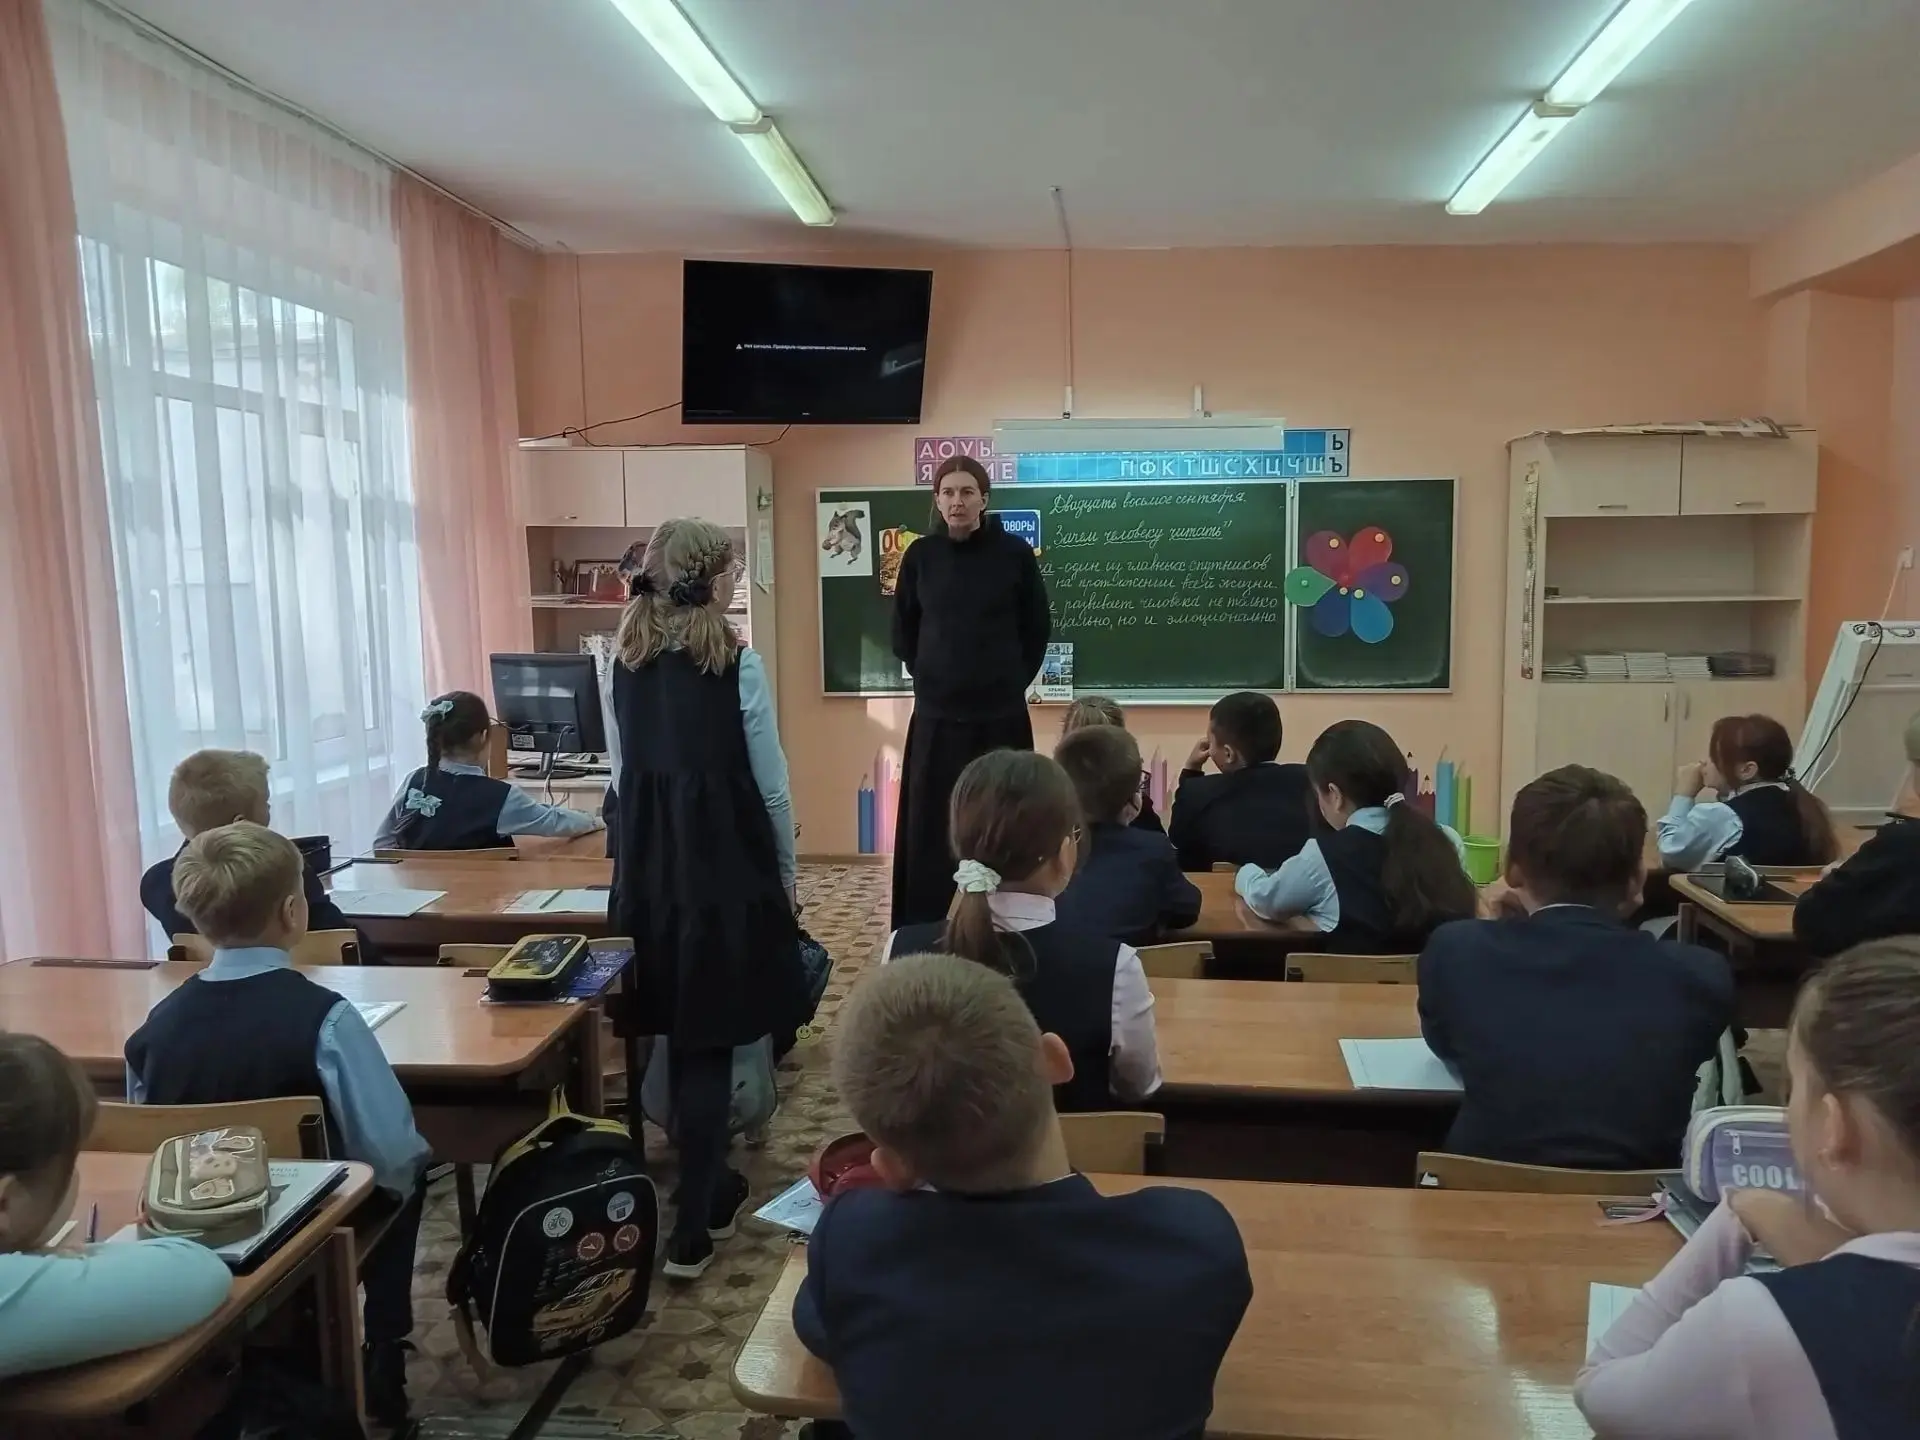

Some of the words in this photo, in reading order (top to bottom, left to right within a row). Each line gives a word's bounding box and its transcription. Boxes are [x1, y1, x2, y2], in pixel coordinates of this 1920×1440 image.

[1049, 494, 1117, 519] Двадцать
[1122, 491, 1173, 508] восьмое
[1103, 520, 1164, 549] человеку
[1106, 561, 1122, 580] из
[1127, 553, 1186, 571] главных
[1189, 553, 1272, 580] спутников
[1056, 577, 1073, 588] на
[1063, 592, 1135, 620] развивает
[1140, 591, 1200, 609] человека
[1208, 596, 1224, 608] не
[1227, 595, 1279, 608] только
[1118, 616, 1137, 626] но
[1145, 615, 1158, 625] и
[1166, 611, 1277, 627] эмоционально
[1732, 1163, 1799, 1190] COOL
